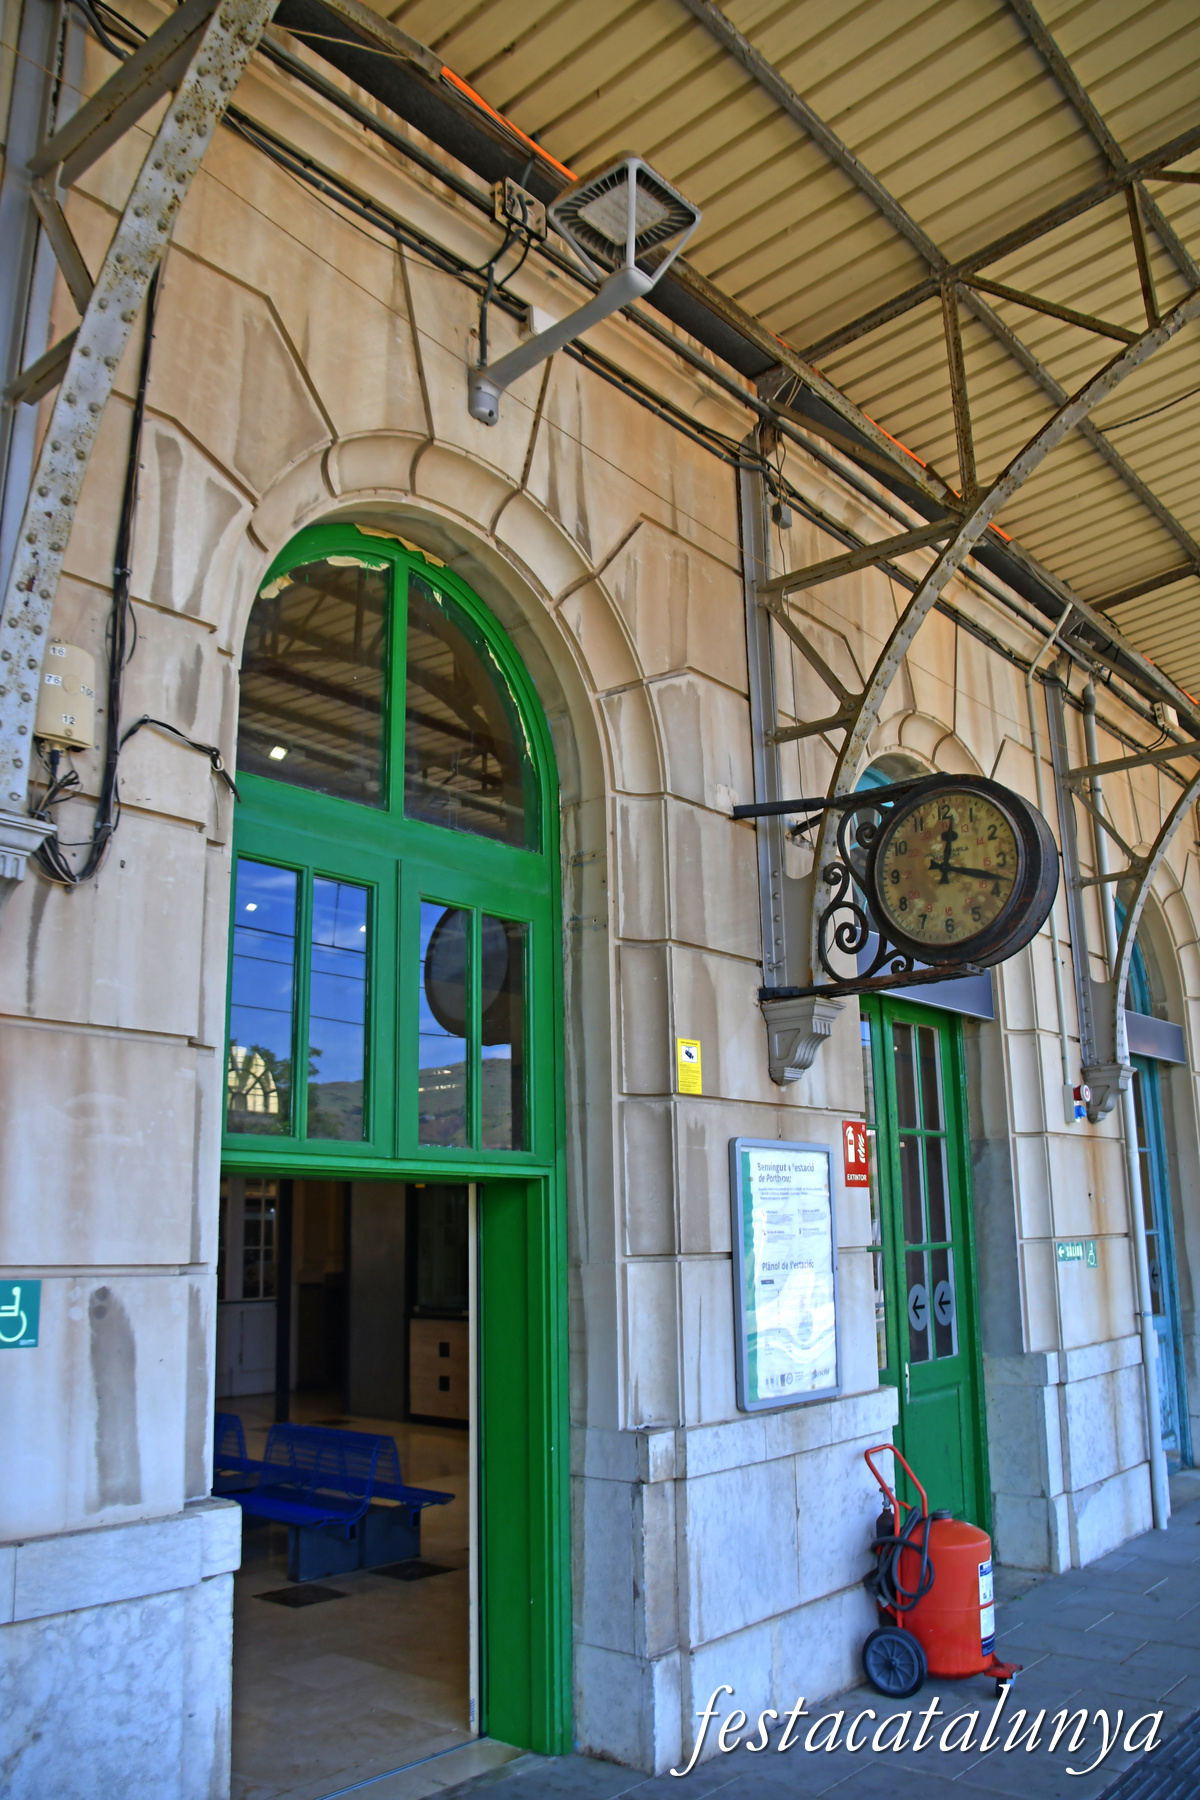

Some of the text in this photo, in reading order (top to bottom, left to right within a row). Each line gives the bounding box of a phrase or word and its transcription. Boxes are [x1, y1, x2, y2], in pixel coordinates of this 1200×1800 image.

[51, 646, 65, 656] 16
[46, 674, 61, 684] 76
[63, 715, 76, 725] 12
[938, 805, 951, 821] 12
[969, 807, 973, 823] 1
[914, 817, 924, 832] 11
[961, 824, 969, 833] 13
[987, 824, 998, 841] 2
[976, 837, 985, 847] 14
[895, 840, 907, 856] 10
[908, 849, 919, 858] 22
[983, 857, 992, 868] 15
[996, 852, 1007, 868] 3
[891, 869, 900, 885] 9
[979, 880, 988, 889] 16
[991, 878, 1001, 897] 4
[909, 890, 920, 900] 20
[899, 896, 908, 912] 8
[964, 897, 972, 907] 17
[925, 903, 932, 913] 19
[945, 906, 952, 917] 18
[971, 905, 982, 923] 5
[918, 914, 928, 930] 7
[945, 918, 955, 934] 6
[758, 1175, 766, 1183] de
[847, 1173, 868, 1181] EXTINTOR
[781, 1262, 789, 1270] de
